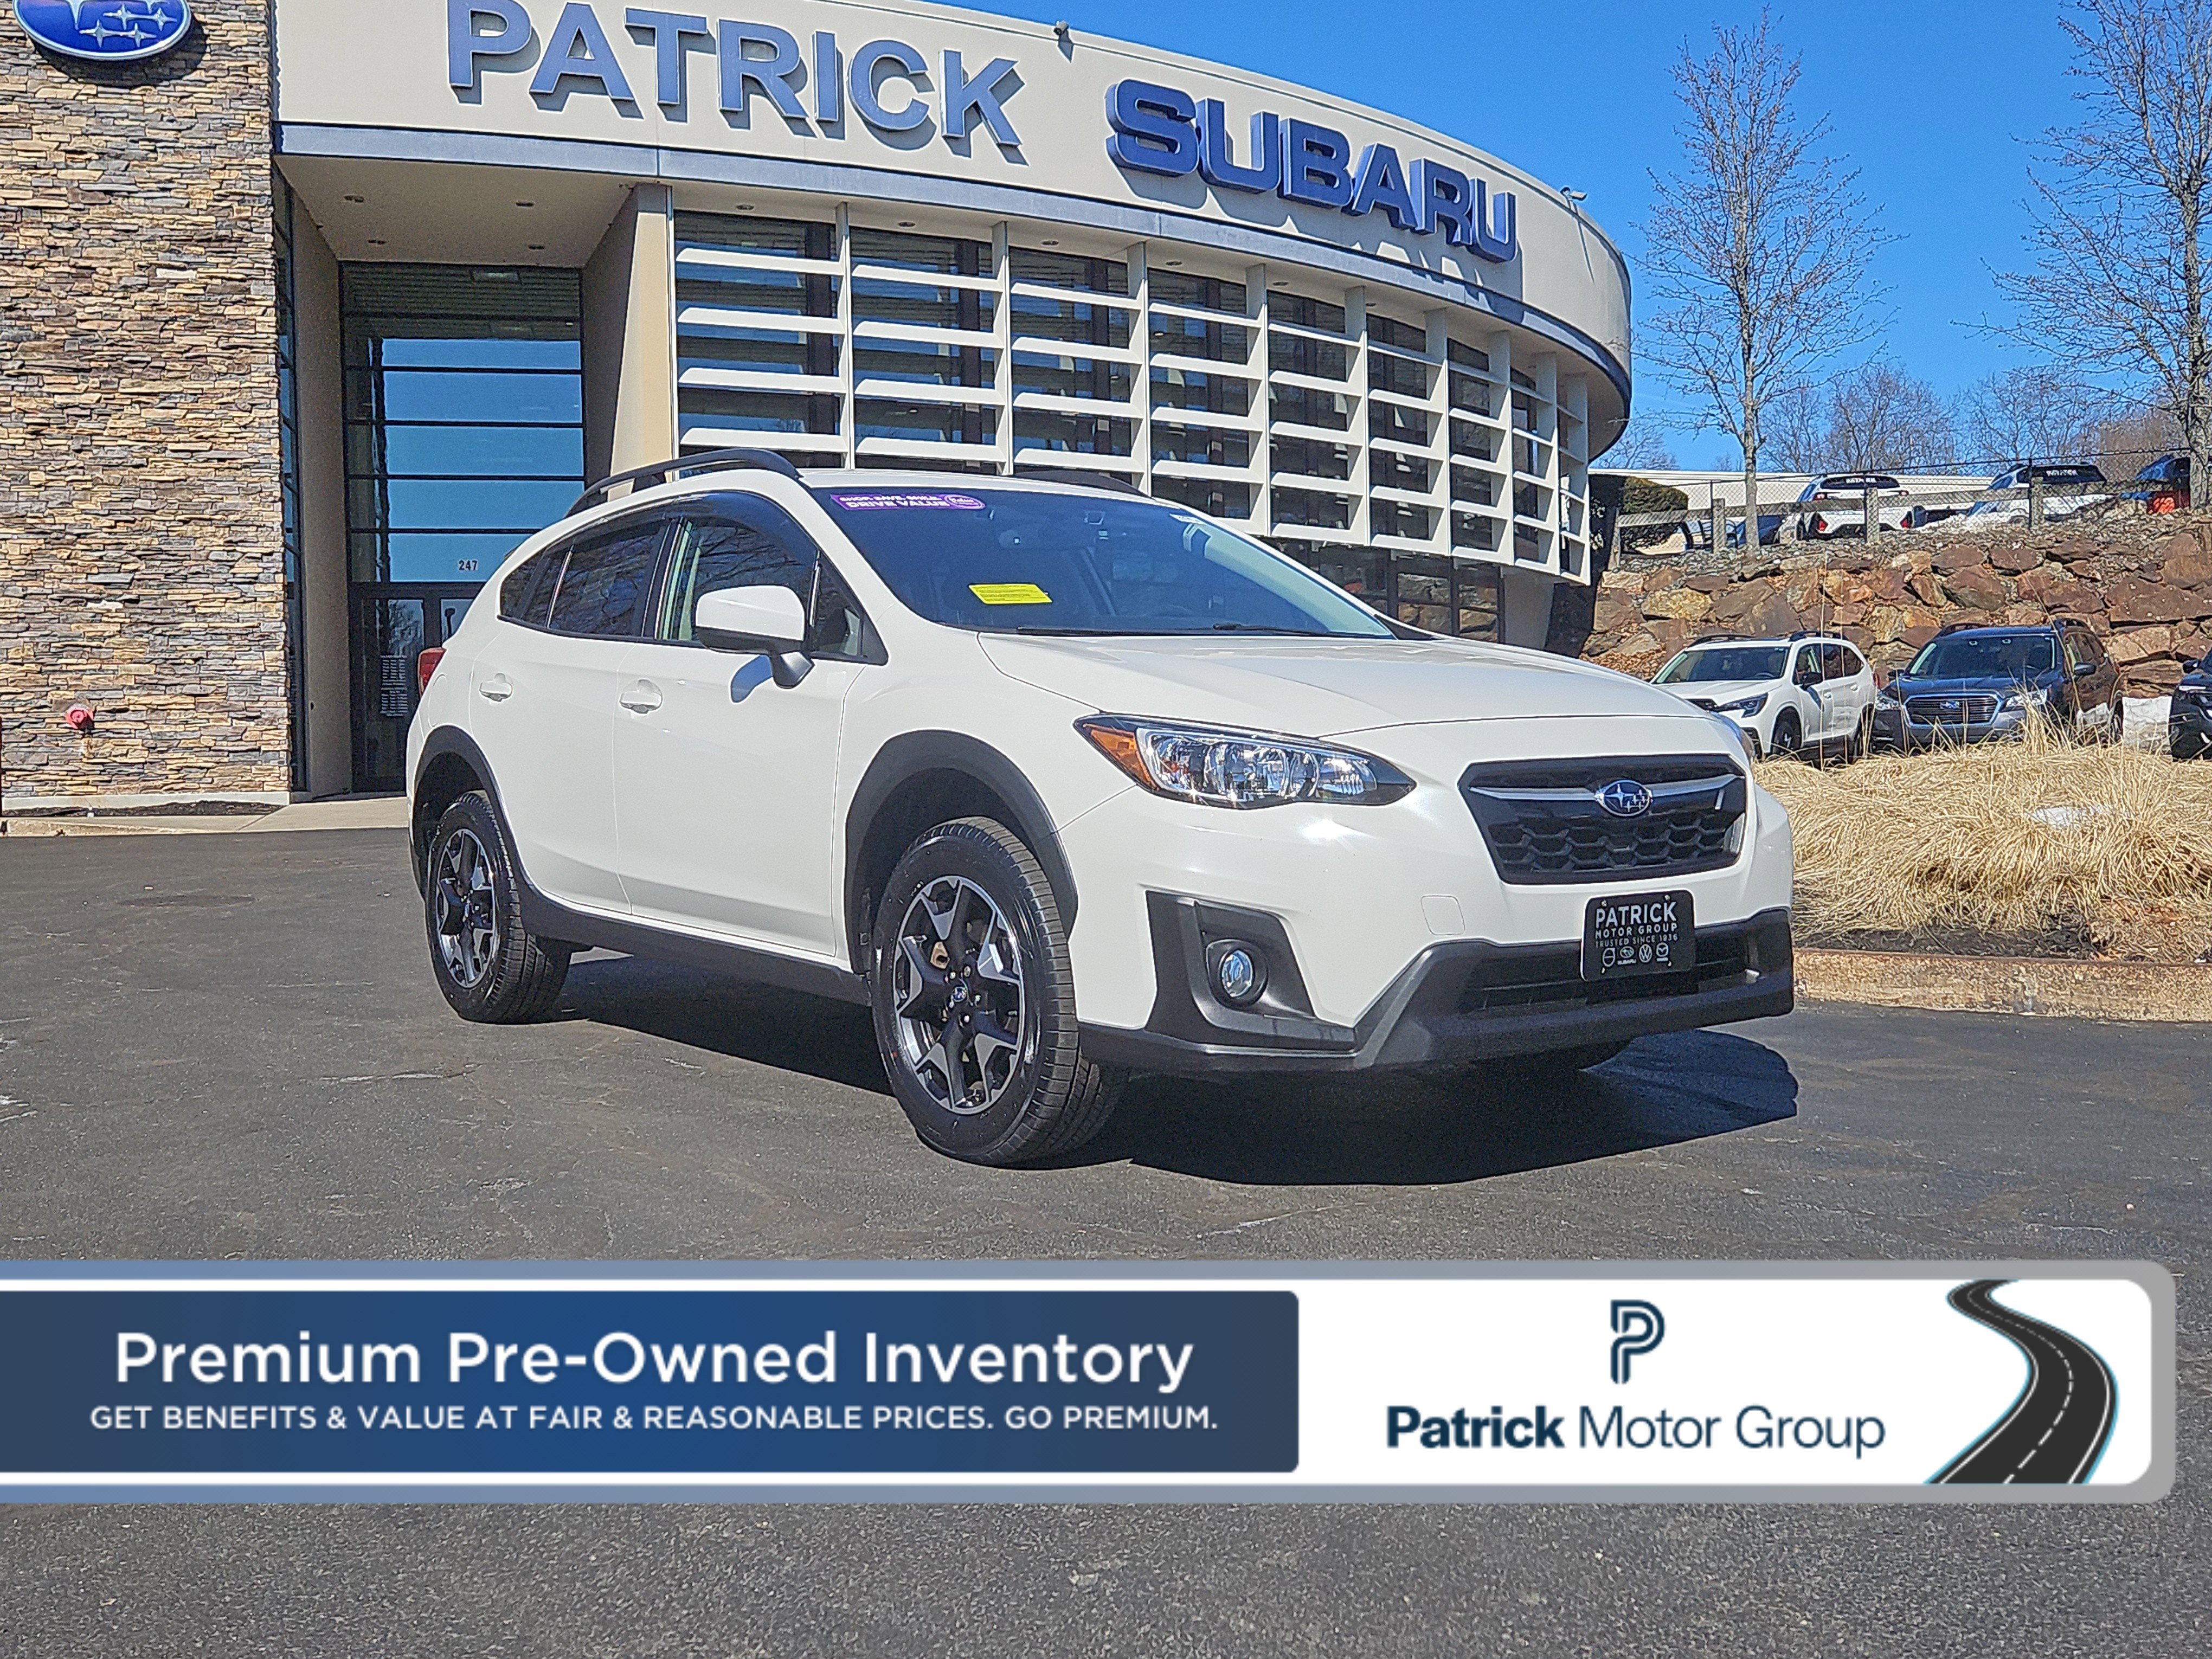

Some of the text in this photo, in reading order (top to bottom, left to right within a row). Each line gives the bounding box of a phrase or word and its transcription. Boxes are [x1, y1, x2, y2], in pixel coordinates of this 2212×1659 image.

[447, 0, 1023, 147] PATRICK
[1104, 78, 1517, 263] SUBARU
[458, 560, 478, 571] 247
[1596, 901, 1677, 928] PATRICK
[1595, 923, 1677, 939] MOTOR GROUP
[1595, 938, 1629, 948] TRUSTED
[1632, 935, 1656, 944] SINCE
